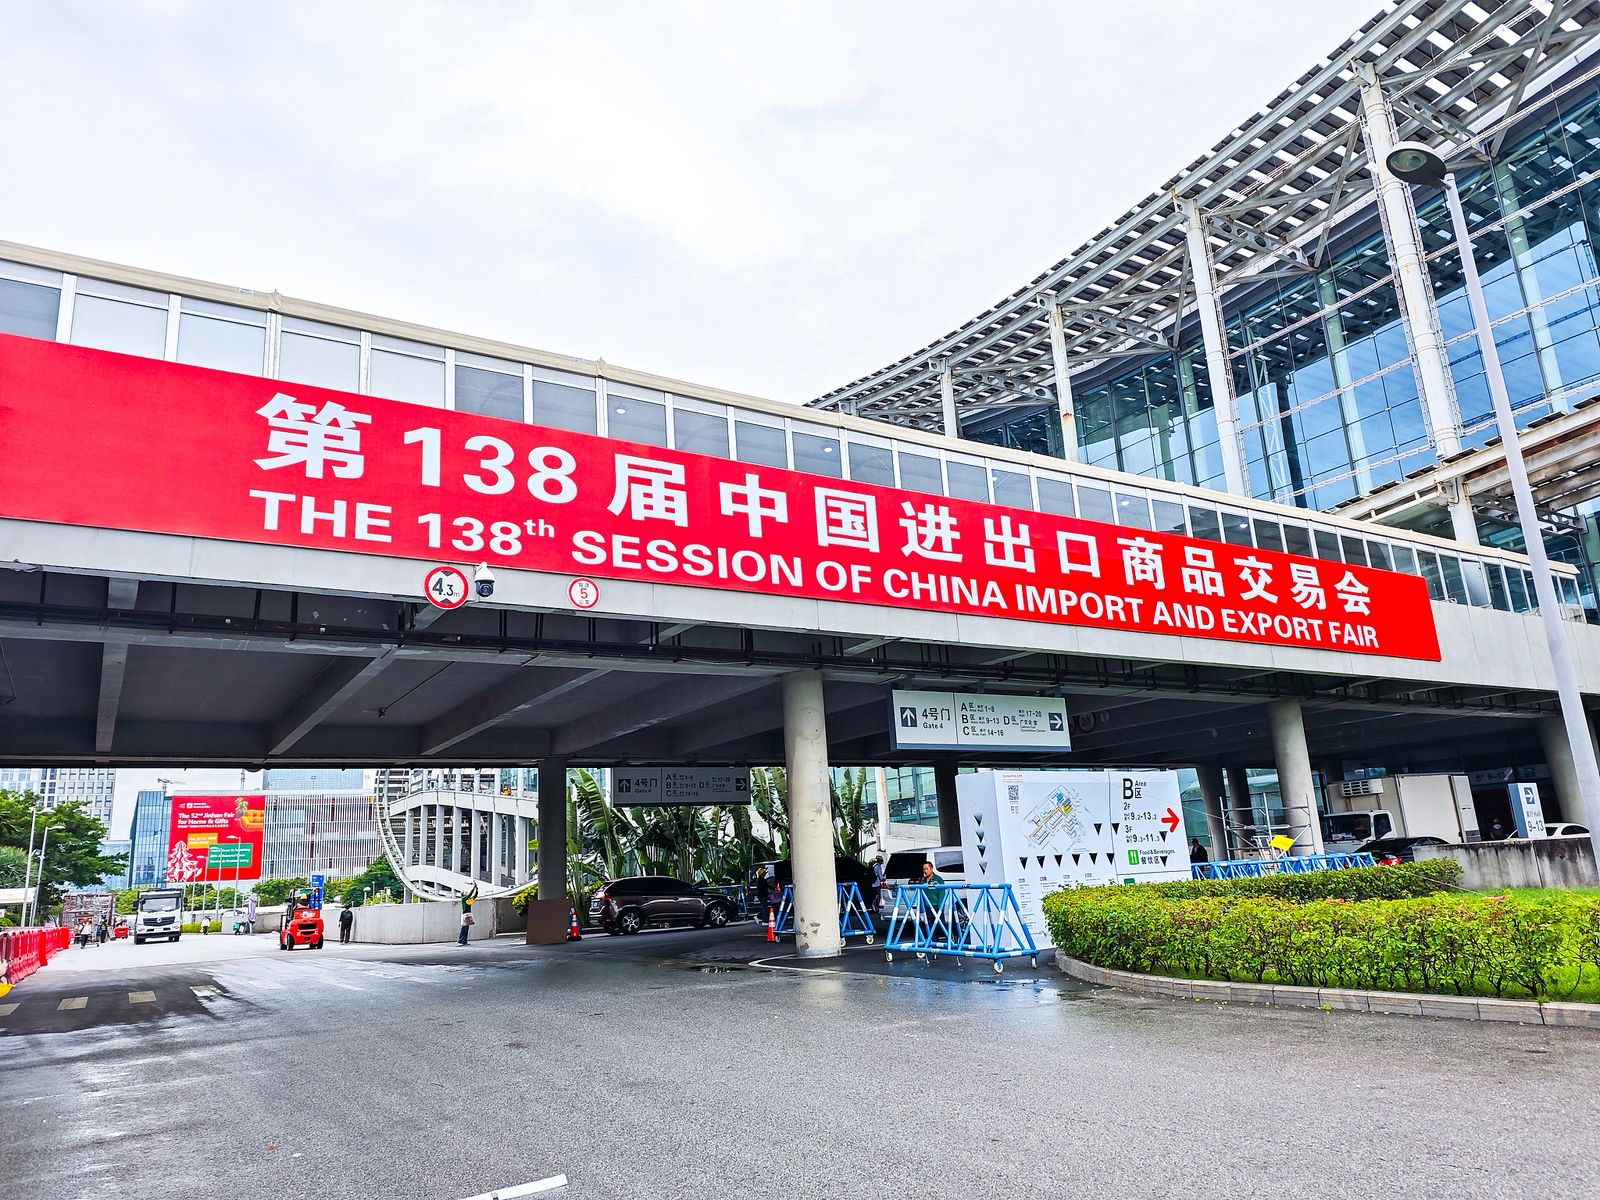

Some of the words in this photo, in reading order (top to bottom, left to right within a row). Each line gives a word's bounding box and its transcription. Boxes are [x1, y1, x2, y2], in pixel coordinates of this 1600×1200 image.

[249, 489, 392, 543] THE
[571, 530, 803, 587] SESSION
[815, 560, 872, 594] OF
[883, 568, 1008, 609] CHINA
[1015, 583, 1144, 623] IMPORT
[1153, 601, 1215, 630] AND
[1220, 608, 1323, 641] EXPORT
[1328, 621, 1379, 648] FAIR
[580, 587, 588, 599] 5
[961, 702, 969, 712] A
[921, 707, 951, 722] 4号门
[962, 714, 969, 724] B
[986, 717, 1000, 725] 9-13
[1003, 715, 1010, 725] D
[922, 721, 939, 730] Gate
[939, 722, 944, 730] 4
[963, 726, 970, 736] C
[1122, 778, 1134, 800] B
[1134, 787, 1142, 799] 区
[1123, 801, 1131, 811] 2F
[1124, 824, 1132, 833] 3F
[1527, 820, 1544, 832] 9-13
